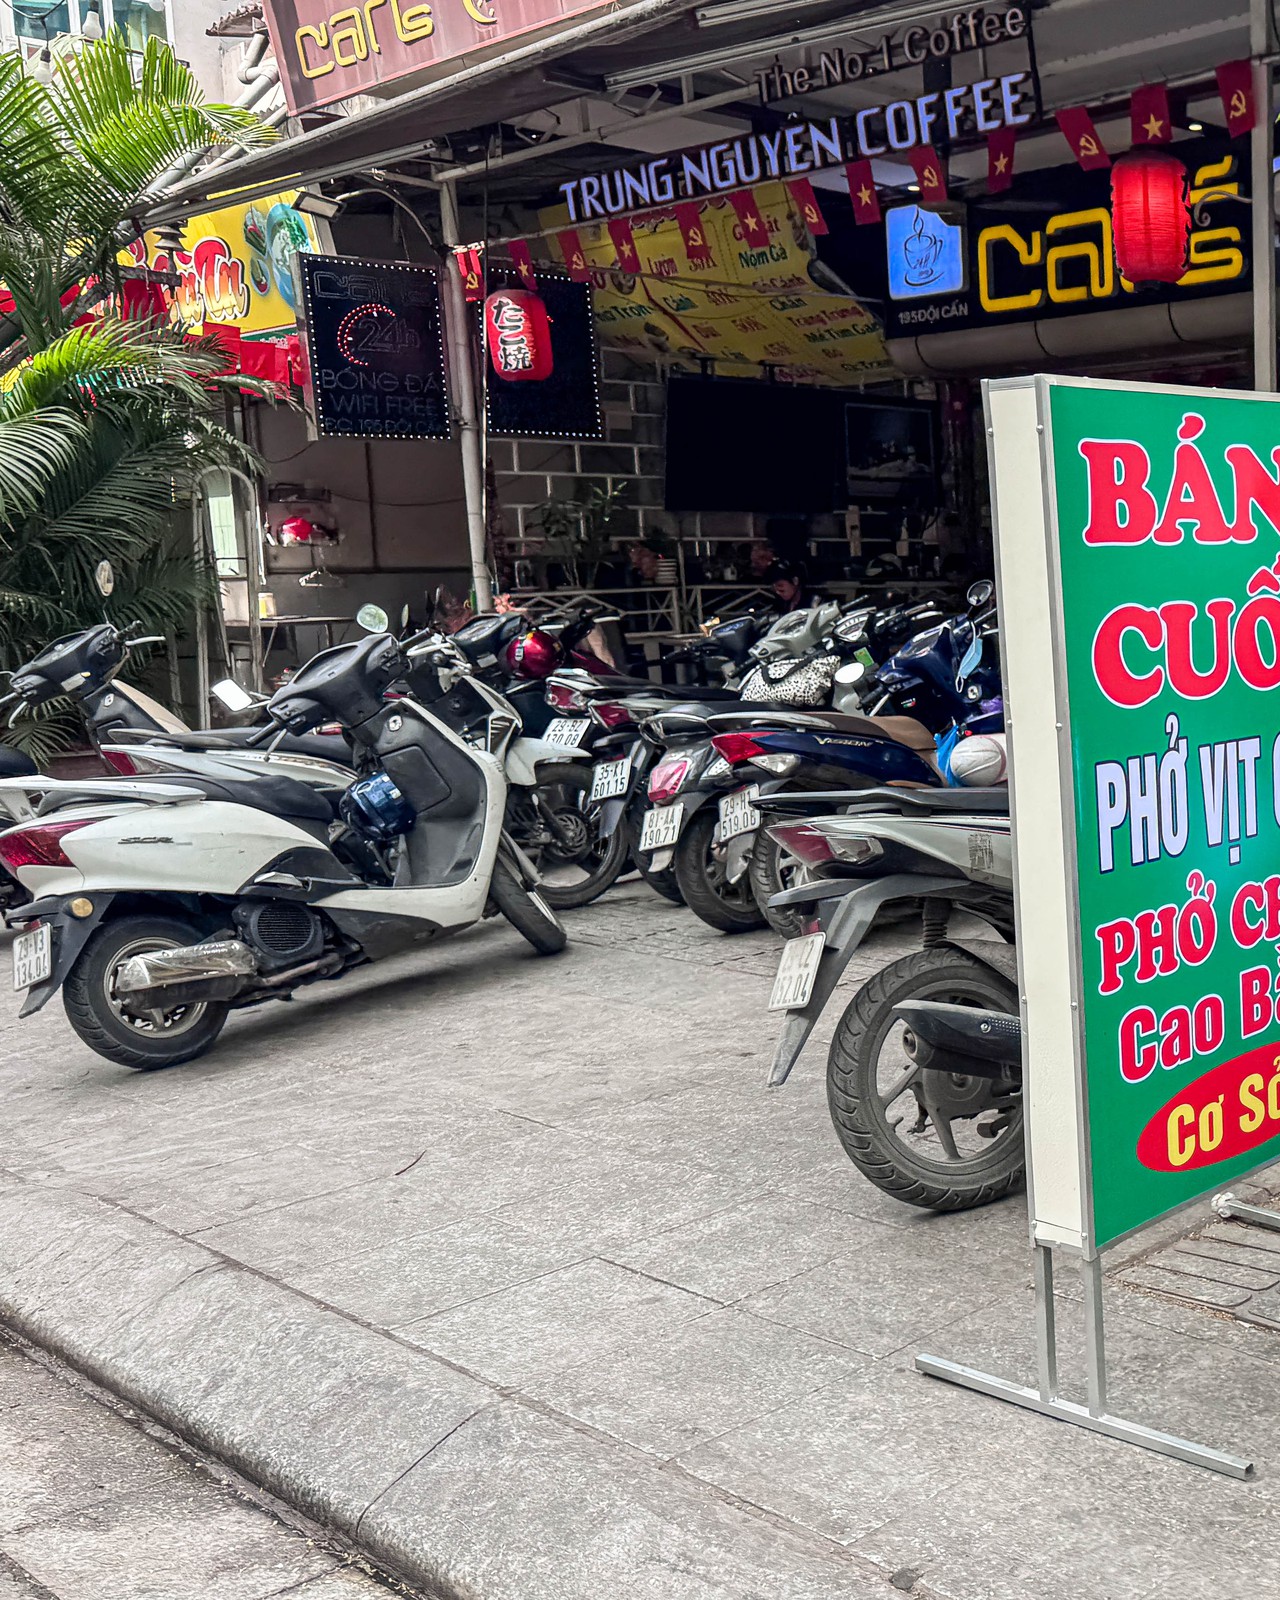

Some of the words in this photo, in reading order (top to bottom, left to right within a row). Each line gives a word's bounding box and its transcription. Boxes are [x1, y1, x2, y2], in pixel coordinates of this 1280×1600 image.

[753, 64, 812, 102] The
[903, 7, 1026, 63] Coffee
[558, 156, 674, 223] TRUNG
[681, 112, 844, 196] NGUYÊN
[856, 72, 1032, 156] COFFEE
[321, 364, 400, 392] BÓNG
[331, 393, 380, 415] WIFI
[593, 777, 626, 799] 601.15
[1095, 713, 1190, 874] PHỞ
[1198, 734, 1262, 865] VỊT
[1095, 868, 1217, 997] PHỞ
[1117, 993, 1225, 1085] Cao
[1166, 1093, 1226, 1167] Cơ
